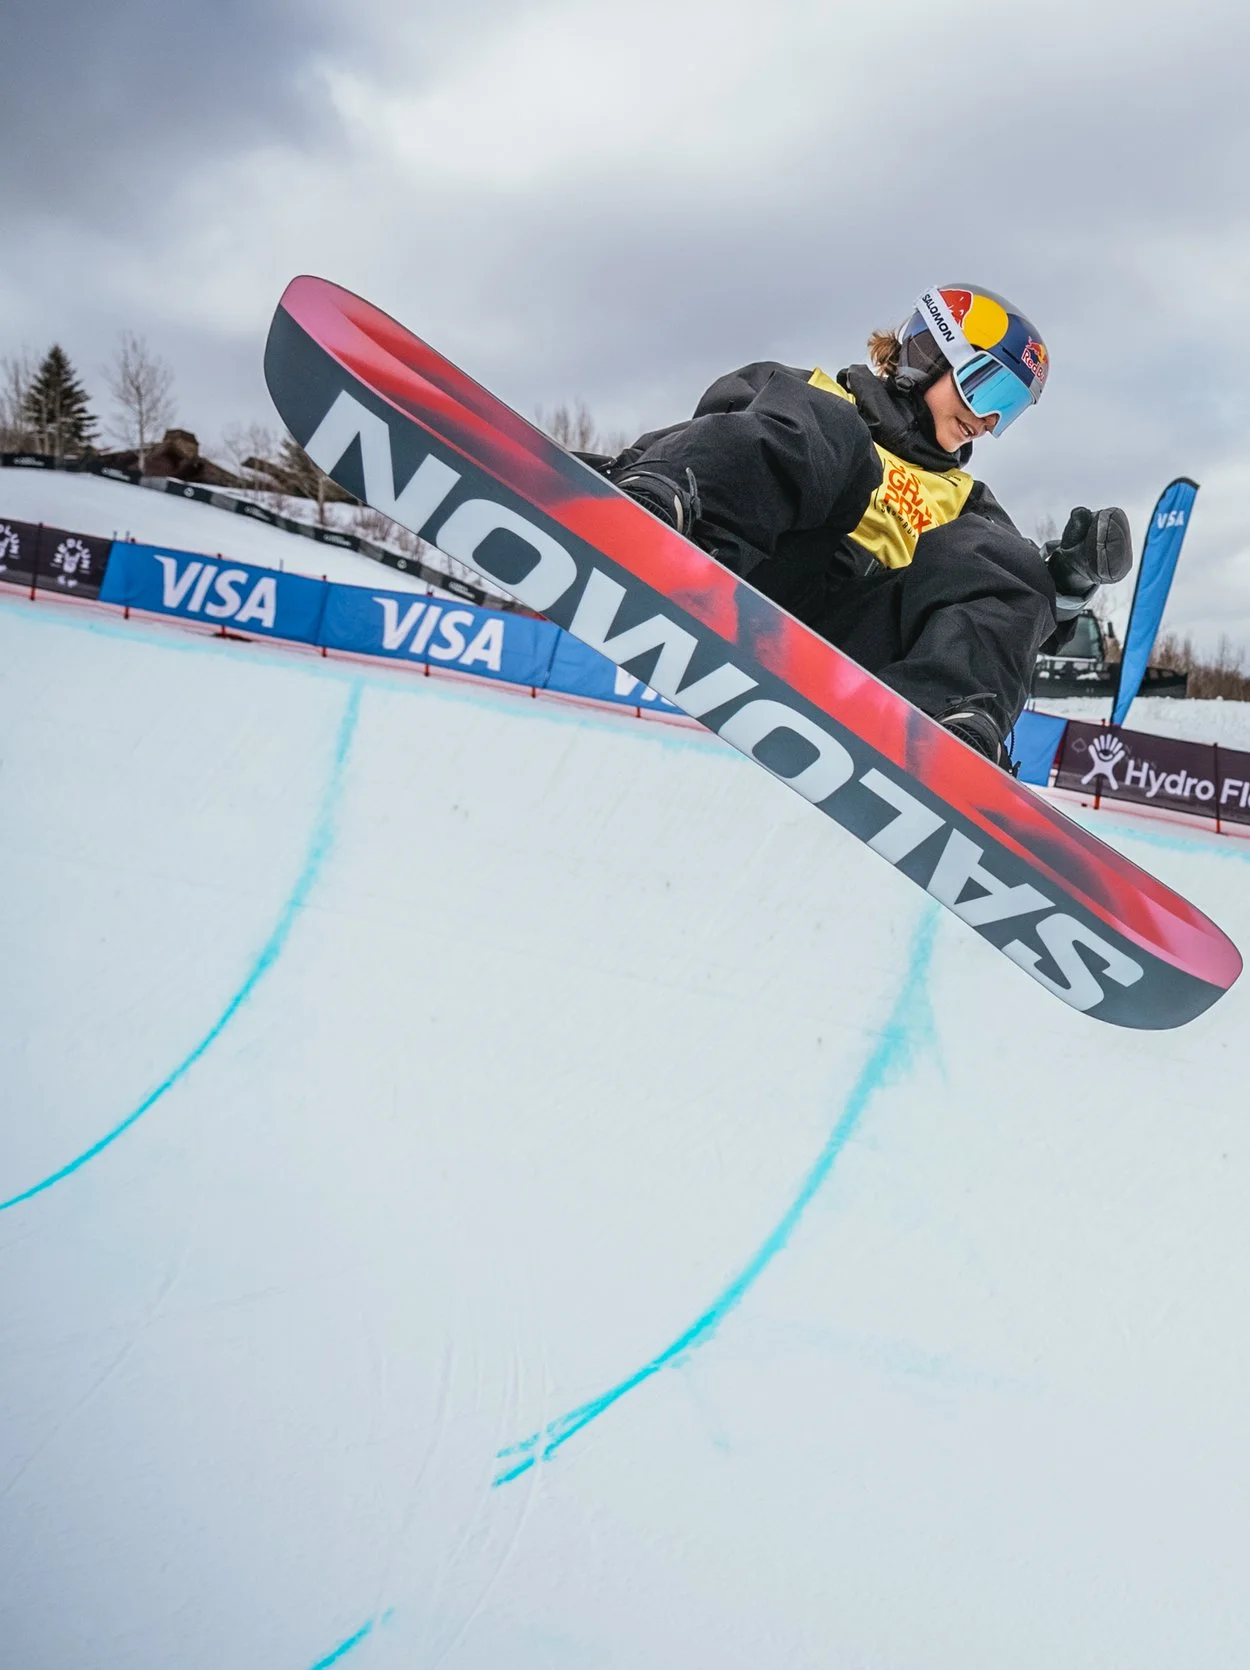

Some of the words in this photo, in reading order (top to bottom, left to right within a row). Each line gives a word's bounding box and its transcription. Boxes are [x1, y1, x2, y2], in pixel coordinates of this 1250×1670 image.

[922, 294, 955, 342] SALOMON
[1021, 348, 1041, 377] Red
[1157, 510, 1185, 529] VSA
[153, 553, 277, 629] VISA
[372, 596, 505, 672] VISA
[301, 389, 1145, 1013] SALOMON
[1125, 759, 1215, 800] Hydro
